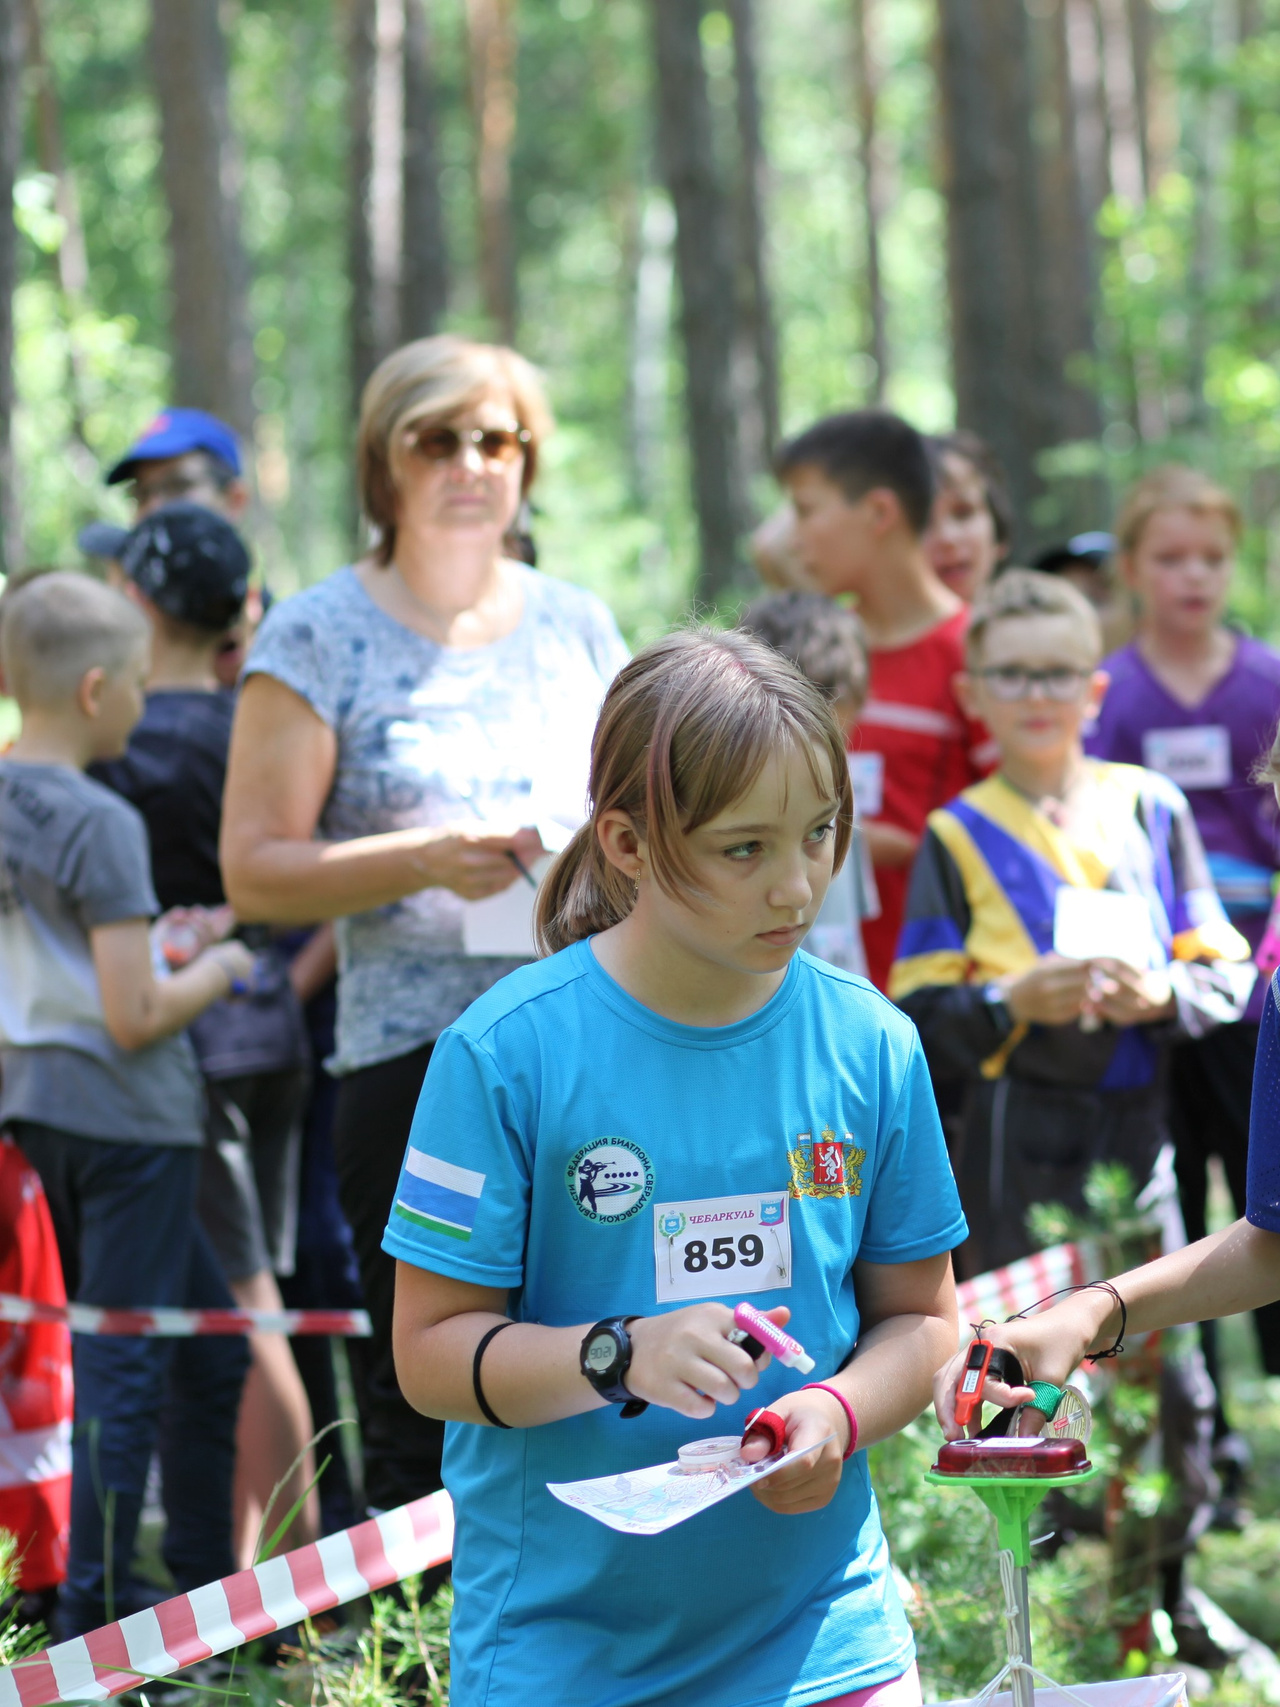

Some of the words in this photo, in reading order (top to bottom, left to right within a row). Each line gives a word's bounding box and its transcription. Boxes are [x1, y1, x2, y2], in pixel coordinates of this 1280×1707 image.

[567, 1137, 609, 1178] ФЕДЕРАЦИЯ
[611, 1137, 652, 1172] БИАТЛОНА
[568, 1184, 598, 1220] ОБЛАСТИ
[598, 1173, 654, 1225] СВЕРДЛОВСКОЙ
[689, 1209, 755, 1225] ЧЕБАРКУЛЬ
[683, 1233, 764, 1273] 859
